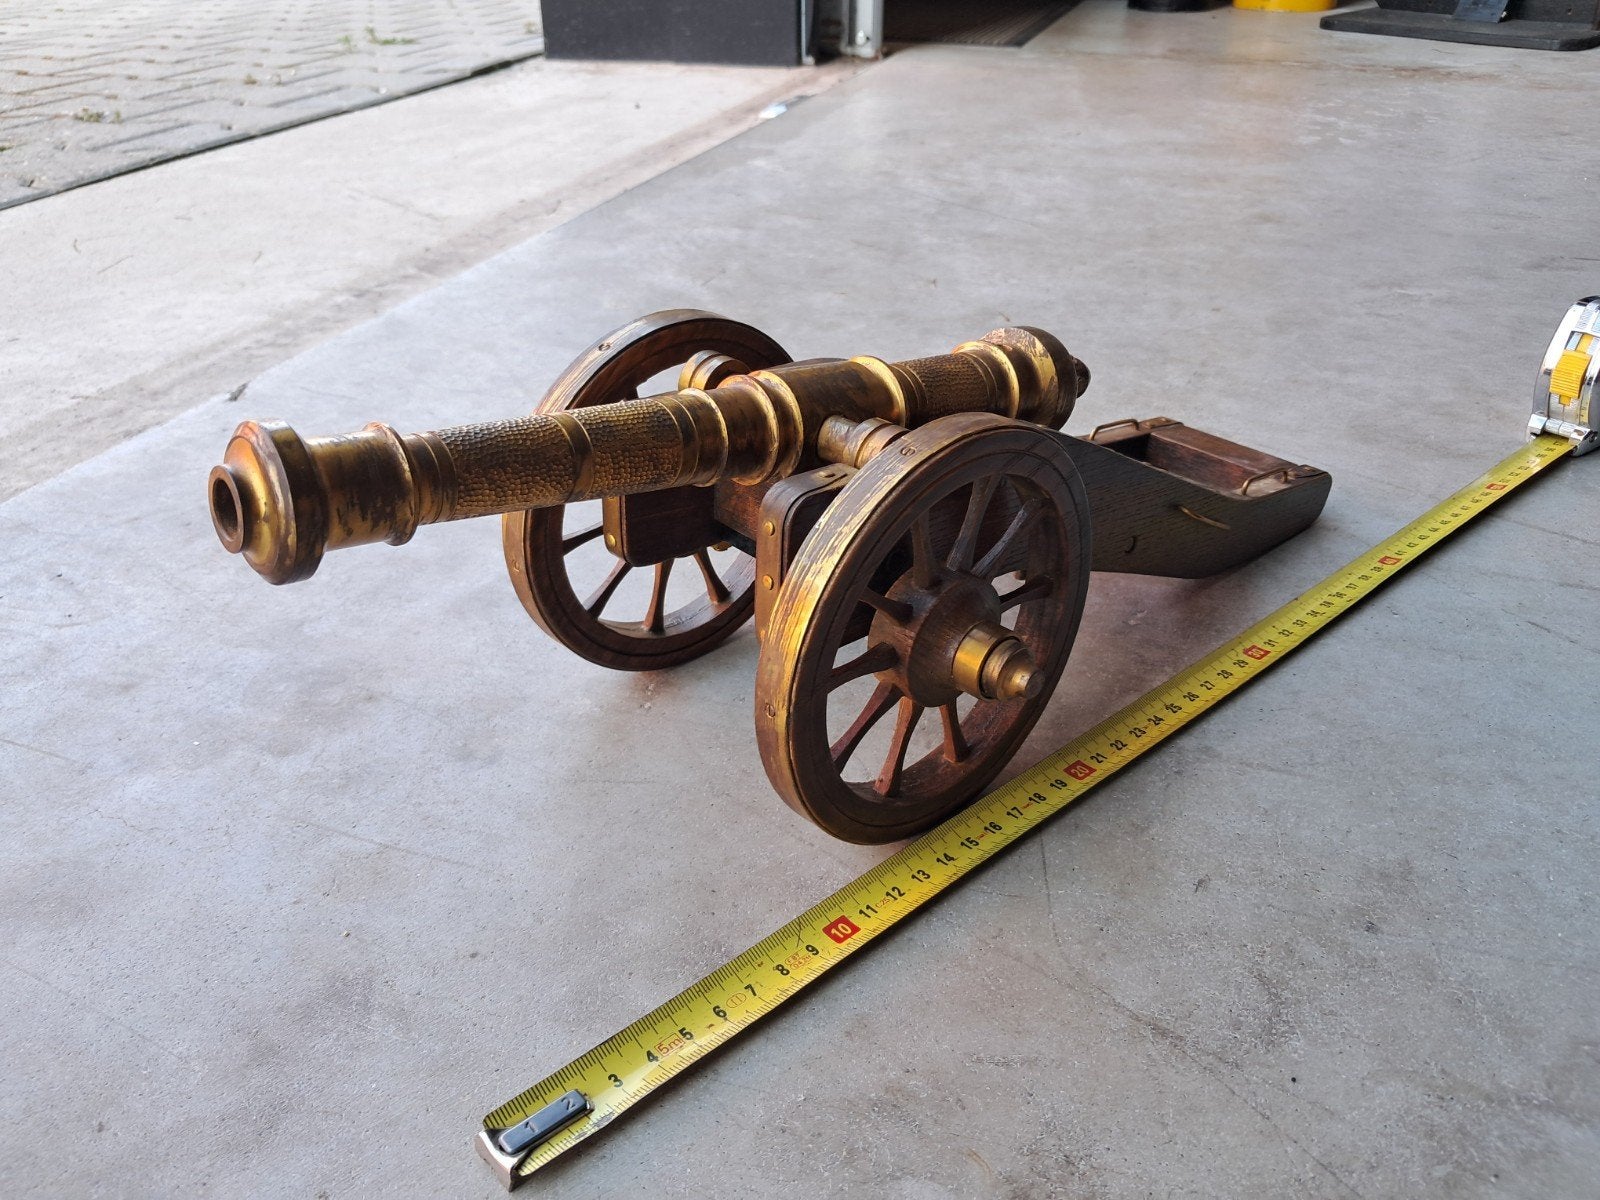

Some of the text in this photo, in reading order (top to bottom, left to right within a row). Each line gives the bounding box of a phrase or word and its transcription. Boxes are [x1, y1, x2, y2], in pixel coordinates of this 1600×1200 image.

[608, 1074, 623, 1087] 3
[646, 1050, 659, 1063] 4
[678, 1027, 693, 1040] 5
[713, 1005, 727, 1018] 6
[744, 984, 757, 996] 7
[775, 964, 790, 976] 8
[805, 944, 819, 956] 9
[831, 923, 852, 938] 10
[859, 904, 878, 919] 11
[885, 886, 906, 900] 12
[911, 869, 931, 883] 13
[936, 852, 956, 866] 14
[960, 836, 980, 850] 15
[984, 821, 1003, 834] 16
[1006, 806, 1024, 819] 17
[1028, 792, 1047, 804] 18
[1049, 779, 1068, 790] 19
[1071, 765, 1090, 777] 20
[1089, 752, 1108, 764] 21
[1109, 740, 1128, 751] 22
[1128, 727, 1147, 738] 23
[1147, 715, 1165, 726] 24
[1165, 703, 1182, 714] 25
[1182, 691, 1200, 702] 26
[1200, 680, 1216, 691] 27
[1217, 669, 1233, 679] 28
[1233, 659, 1249, 668] 29
[1263, 639, 1280, 648] 31
[1278, 629, 1294, 638] 32
[1292, 619, 1308, 628] 33
